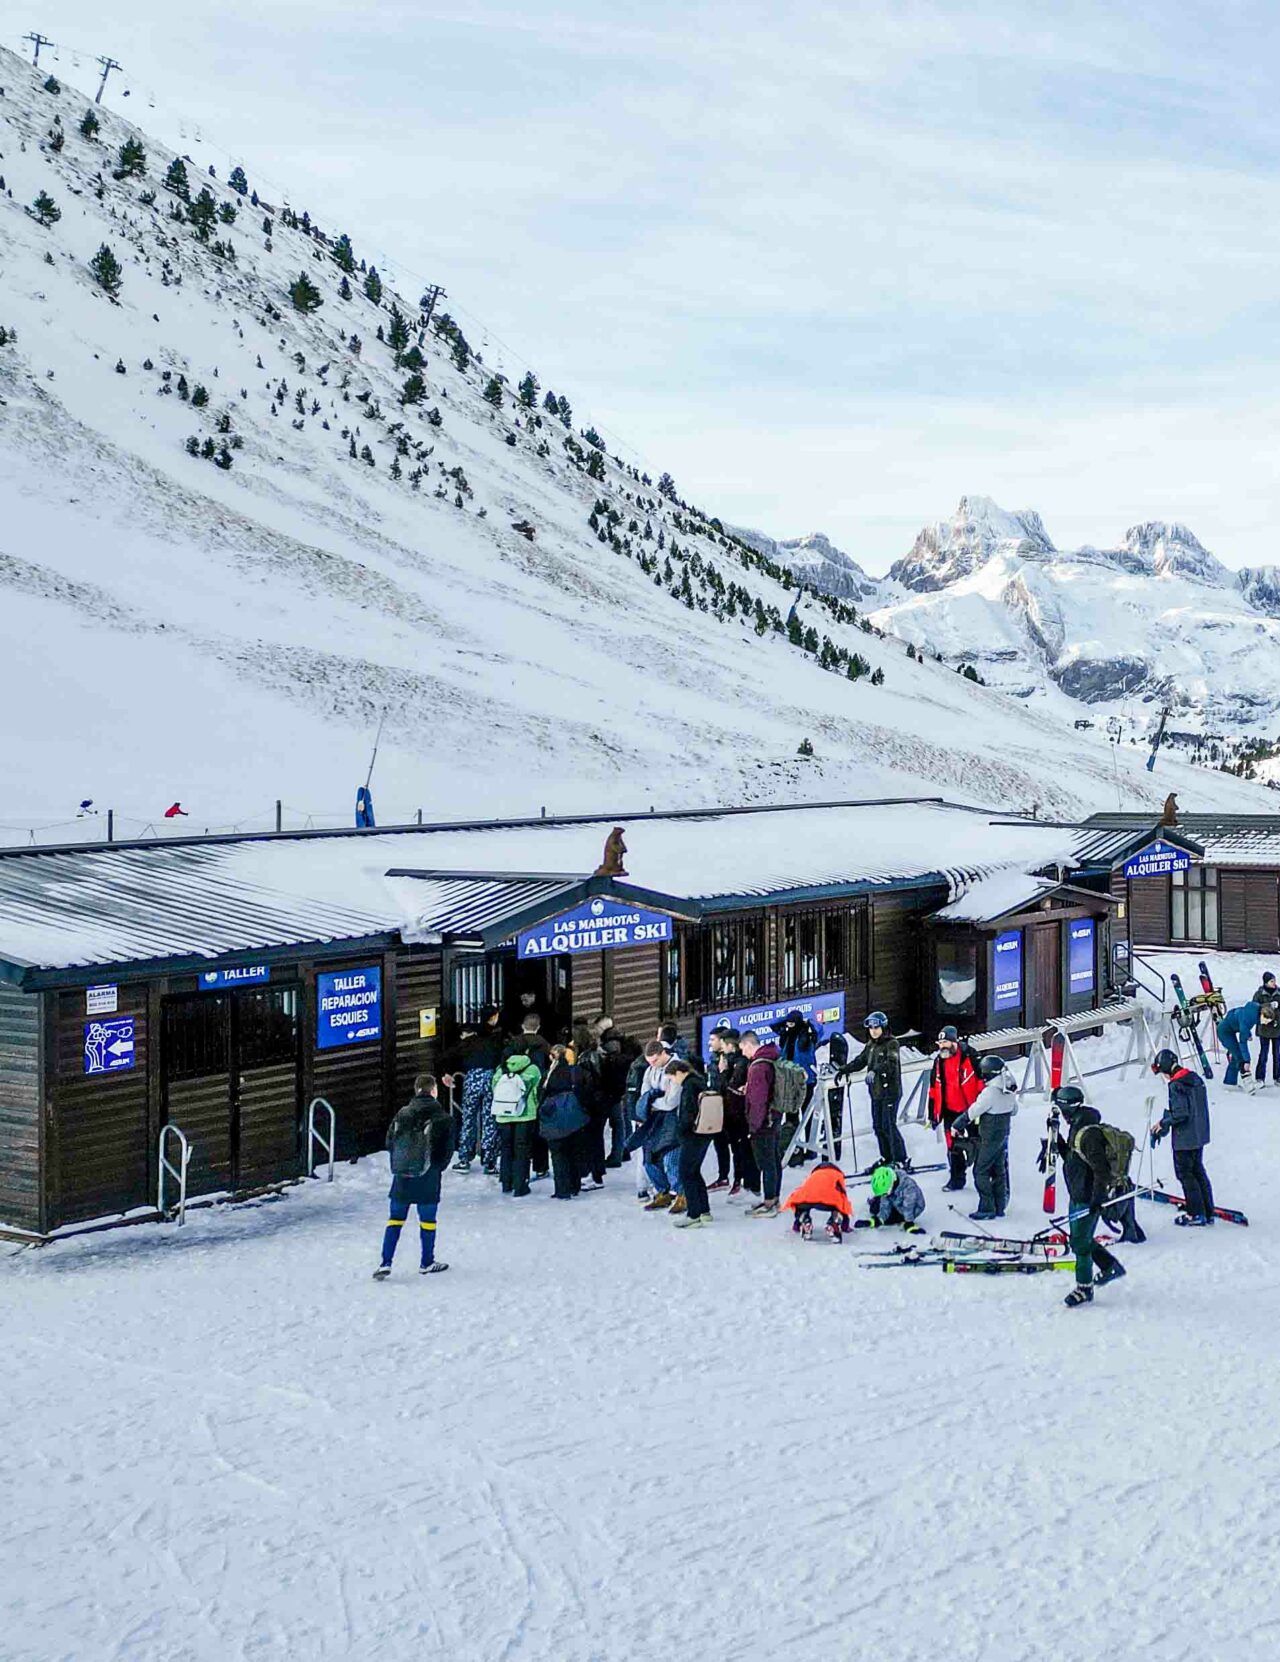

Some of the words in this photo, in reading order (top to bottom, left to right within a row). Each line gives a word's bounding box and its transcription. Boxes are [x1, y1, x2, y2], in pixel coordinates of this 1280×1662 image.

[1126, 860, 1171, 876] ALQUILER
[1173, 858, 1189, 870] SKI
[1139, 854, 1149, 863] LAS
[554, 920, 576, 934] LAS
[579, 913, 641, 930] MARMOTAS
[524, 927, 629, 955] ALQUILER
[633, 922, 668, 940] SKI
[223, 965, 265, 981] TALLER
[333, 975, 366, 991] TALLER
[88, 990, 116, 998] ALARMA
[321, 991, 377, 1011] REPARACION
[330, 1010, 368, 1028] ESQUIES
[739, 1010, 774, 1025] ALQUILER
[776, 1007, 786, 1018] DE
